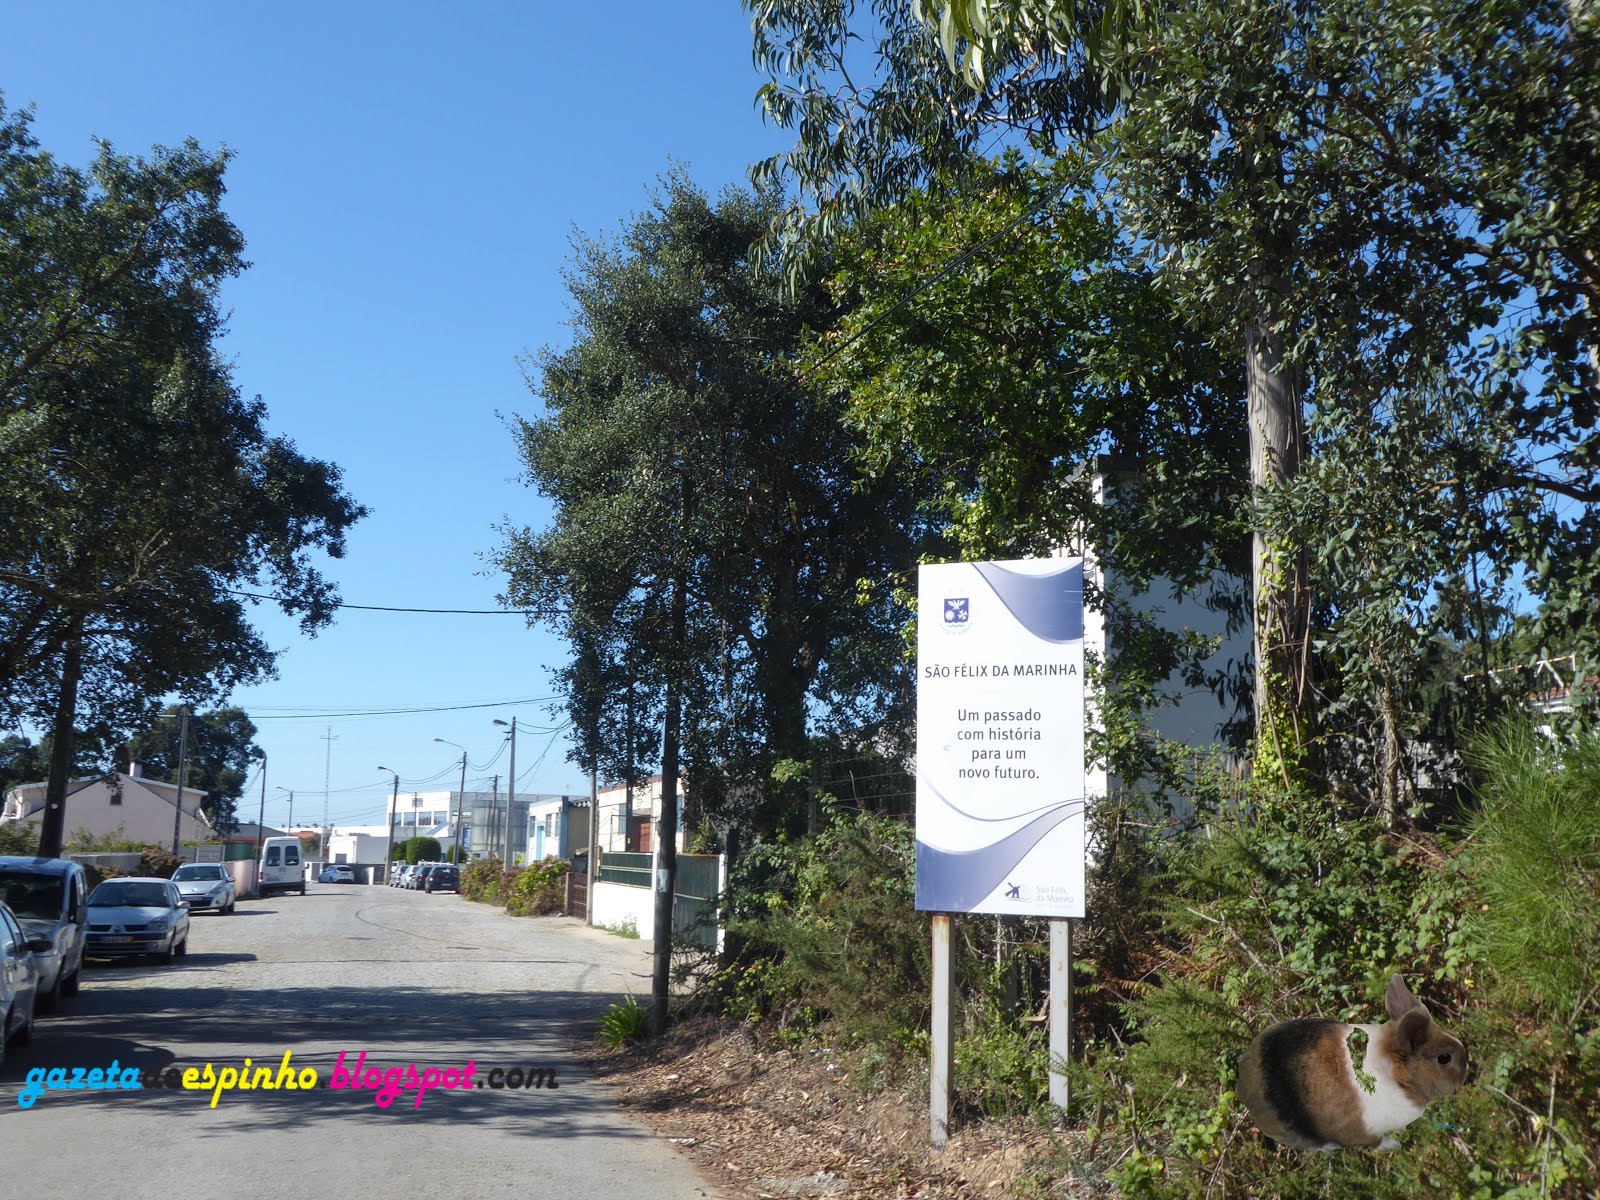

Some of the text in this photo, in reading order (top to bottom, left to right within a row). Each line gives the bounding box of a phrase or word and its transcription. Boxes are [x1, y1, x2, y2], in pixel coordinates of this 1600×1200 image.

[925, 663, 1077, 678] SÃO FÉLIX DA MARINHA
[957, 708, 1041, 724] Um passado
[957, 728, 1041, 741] com história
[971, 749, 1026, 762] para um
[959, 766, 1039, 779] novo futuro.
